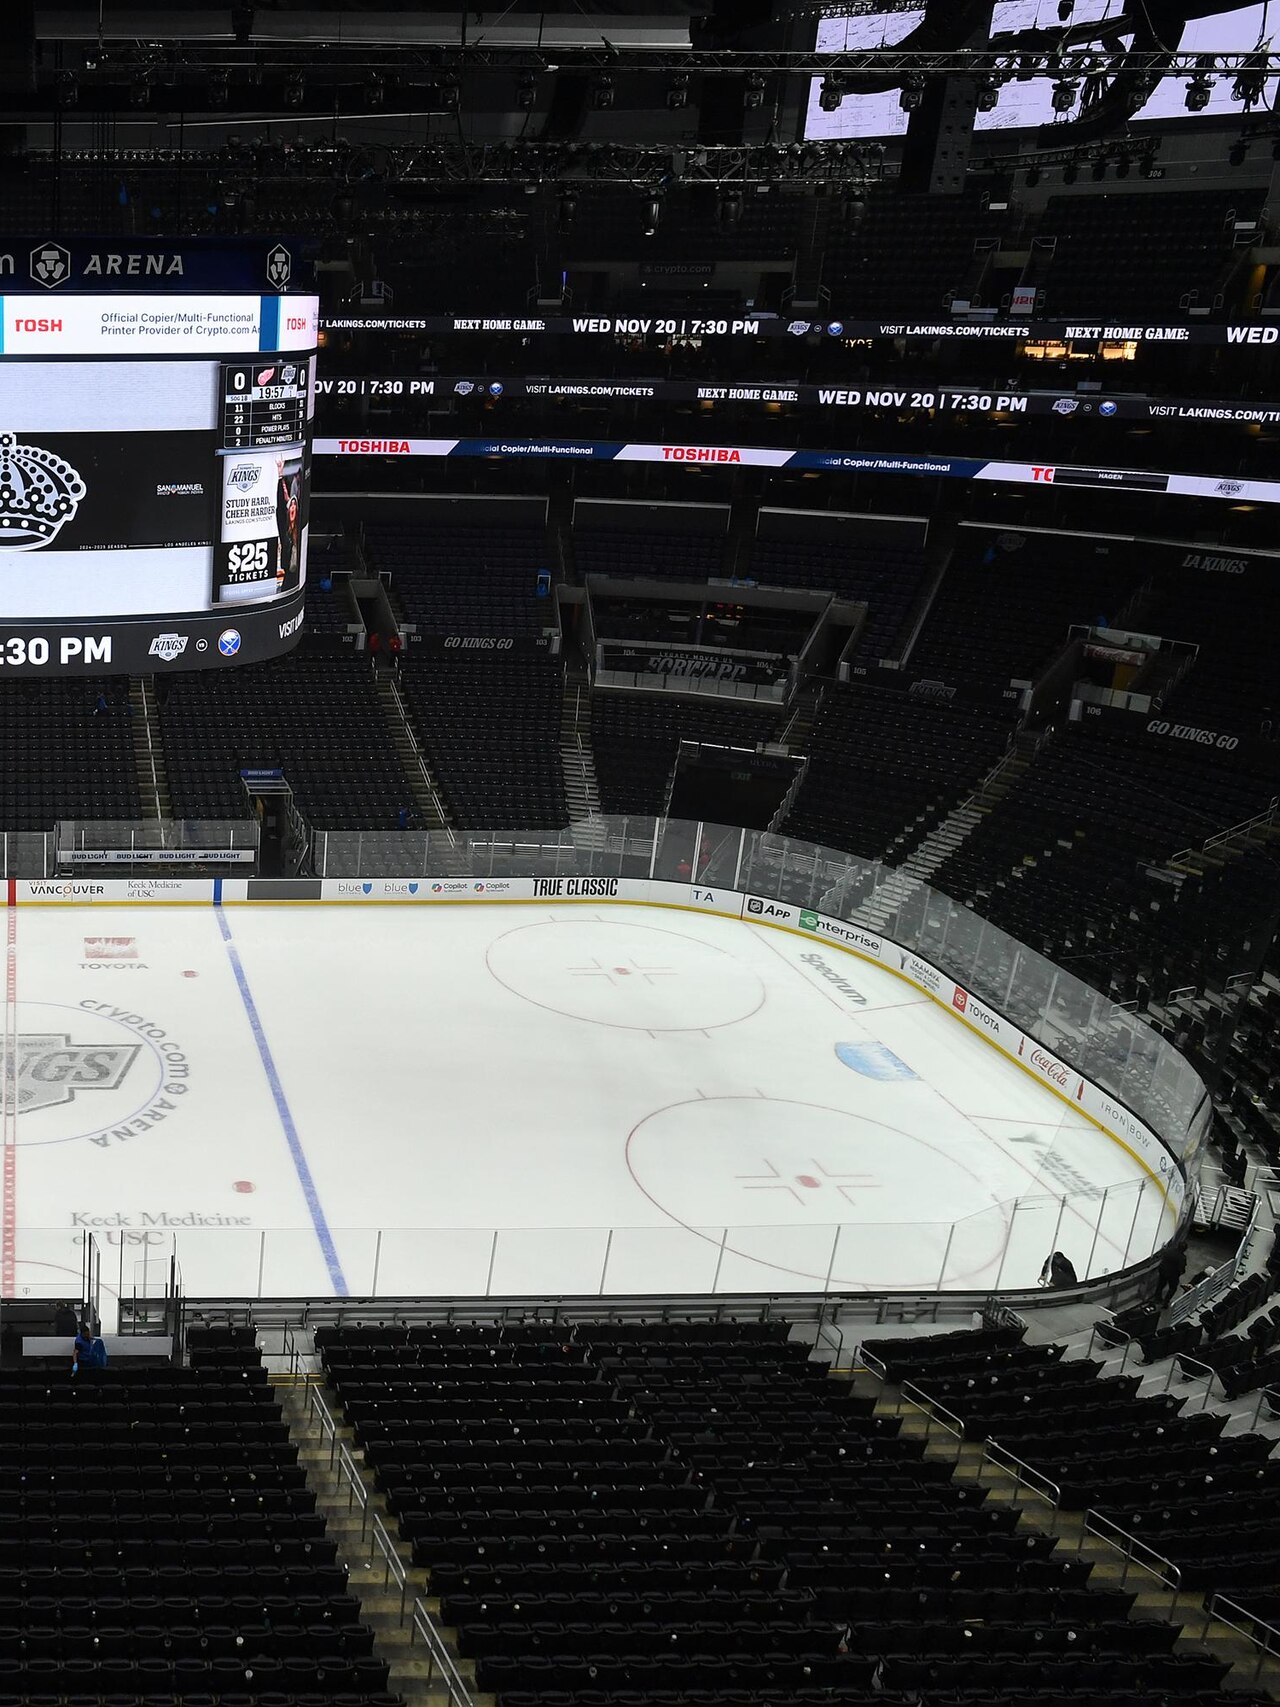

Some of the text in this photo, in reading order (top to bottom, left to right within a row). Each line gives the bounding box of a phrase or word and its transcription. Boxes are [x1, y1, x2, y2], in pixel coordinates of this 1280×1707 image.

[83, 254, 185, 276] ARENA
[101, 312, 254, 324] Official Copier/Multi-Functional
[453, 319, 546, 331] NEXT HOME GAME:
[101, 325, 250, 337] Printer Provider of Crypto.com
[572, 318, 759, 335] WED NOV 20 7:30 PM
[879, 325, 1030, 337] VISIT LAKINGS.COM/TICKETS
[1064, 326, 1190, 341] NEXT HOME GAME:
[233, 372, 246, 391] 0
[259, 386, 284, 399] 19:57
[525, 385, 654, 397] VISIT LAKINGS.COM/TICKETS
[696, 387, 799, 402] NEXT HOME GAME:
[817, 389, 1028, 413] WED NOV 20 7:30 PM
[339, 440, 411, 453] TOSHIBA
[500, 444, 594, 455] Copier/Multi-Functional
[662, 447, 742, 463] TOSHIBA
[842, 458, 951, 472] Copier/Multi-Functional
[225, 505, 276, 520] CHEER HARDER
[228, 541, 269, 574] $25
[228, 568, 269, 583] TICKETS
[443, 636, 514, 650] GO KINGS GO
[60, 636, 113, 665] PM
[1146, 719, 1239, 751] GO KINGS GO
[30, 885, 105, 896] VANCOUVER
[127, 880, 183, 889] Keck Medicine
[338, 883, 362, 893] blue
[384, 883, 408, 893] blue
[443, 882, 468, 892] Copilot
[485, 882, 510, 891] Copilot
[532, 877, 620, 897] TRUE CLASSIC
[127, 889, 155, 898] of USC
[805, 914, 880, 951] enterprise
[78, 962, 149, 970] TOYOTA
[800, 952, 868, 1006] Spectrum
[968, 1003, 1000, 1034] TOYOTA
[1101, 1101, 1151, 1148] IRON BOW
[70, 1210, 252, 1228] Keck Medicine
